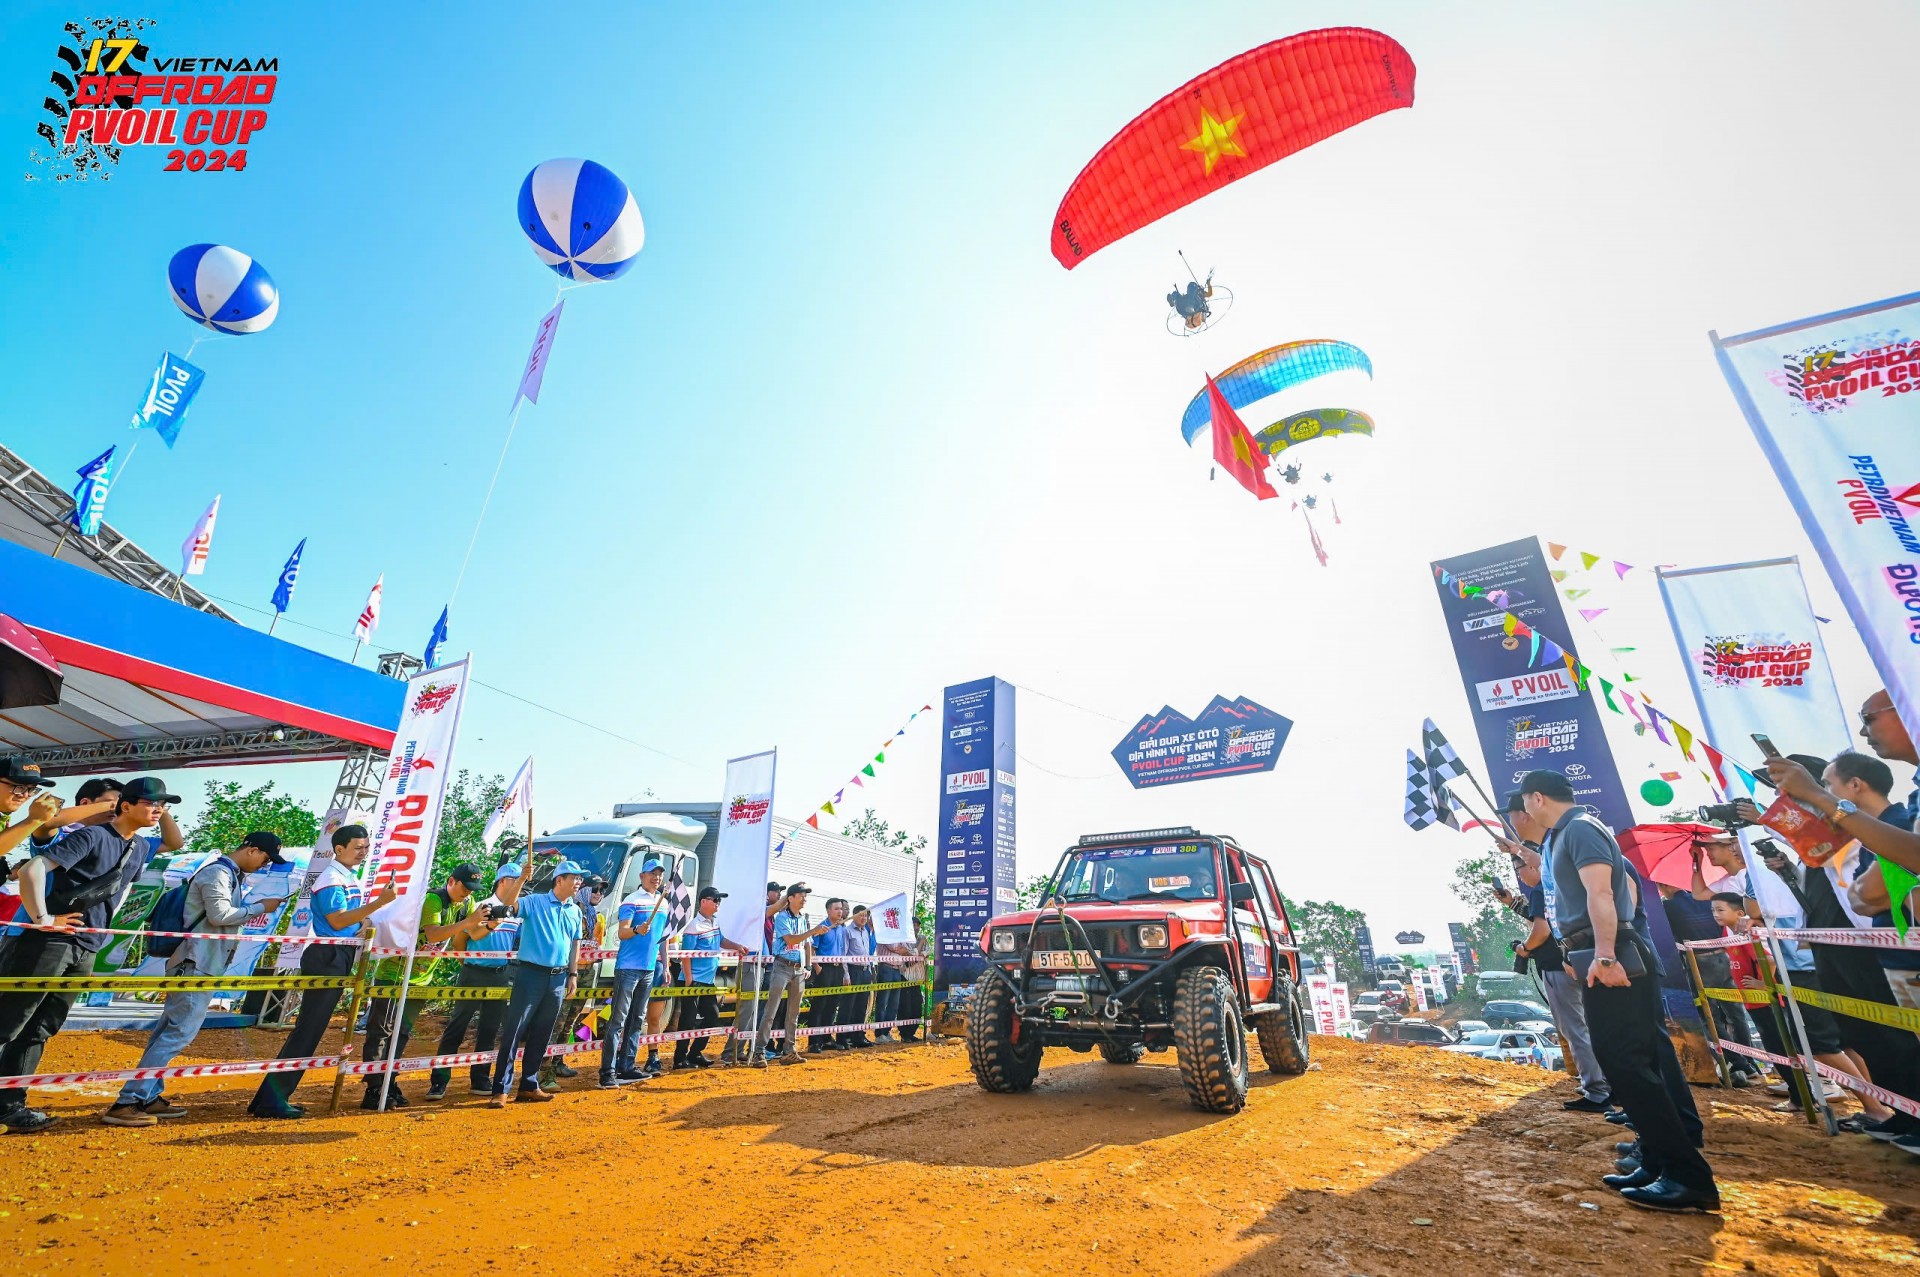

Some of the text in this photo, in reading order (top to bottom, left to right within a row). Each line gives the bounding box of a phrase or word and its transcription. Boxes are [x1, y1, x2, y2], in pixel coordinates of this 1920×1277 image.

[1804, 350, 1837, 372] 17
[154, 365, 191, 417] PVOIL
[1804, 370, 1885, 401] PVOIL
[1837, 479, 1882, 525] PVOIL
[1847, 454, 1920, 555] PETROVIETNAM
[1716, 641, 1812, 655] 17 VIETNAM
[1716, 648, 1812, 664] OFFROAD
[1716, 662, 1810, 679] PVOIL CUP
[1512, 672, 1569, 697] PVOIL
[1762, 678, 1804, 687] 2024
[1515, 723, 1578, 740] OFFROAD
[1516, 719, 1578, 732] 17 VIETNAM
[1181, 732, 1195, 743] XE
[1254, 740, 1274, 751] CUP
[1514, 733, 1578, 752] PVOIL CUP
[1169, 743, 1192, 755] VIỆT
[1195, 739, 1218, 751] NAM
[1548, 744, 1576, 754] 2024
[389, 755, 403, 781] PVOIL
[396, 740, 417, 795] PETROVIETNAM
[1132, 751, 1216, 772] PVOIL CUP 2024
[963, 771, 987, 785] PVOIL
[375, 800, 395, 839] Đường
[373, 842, 383, 855] xa
[1179, 845, 1198, 853] 308
[366, 858, 380, 888] thêm
